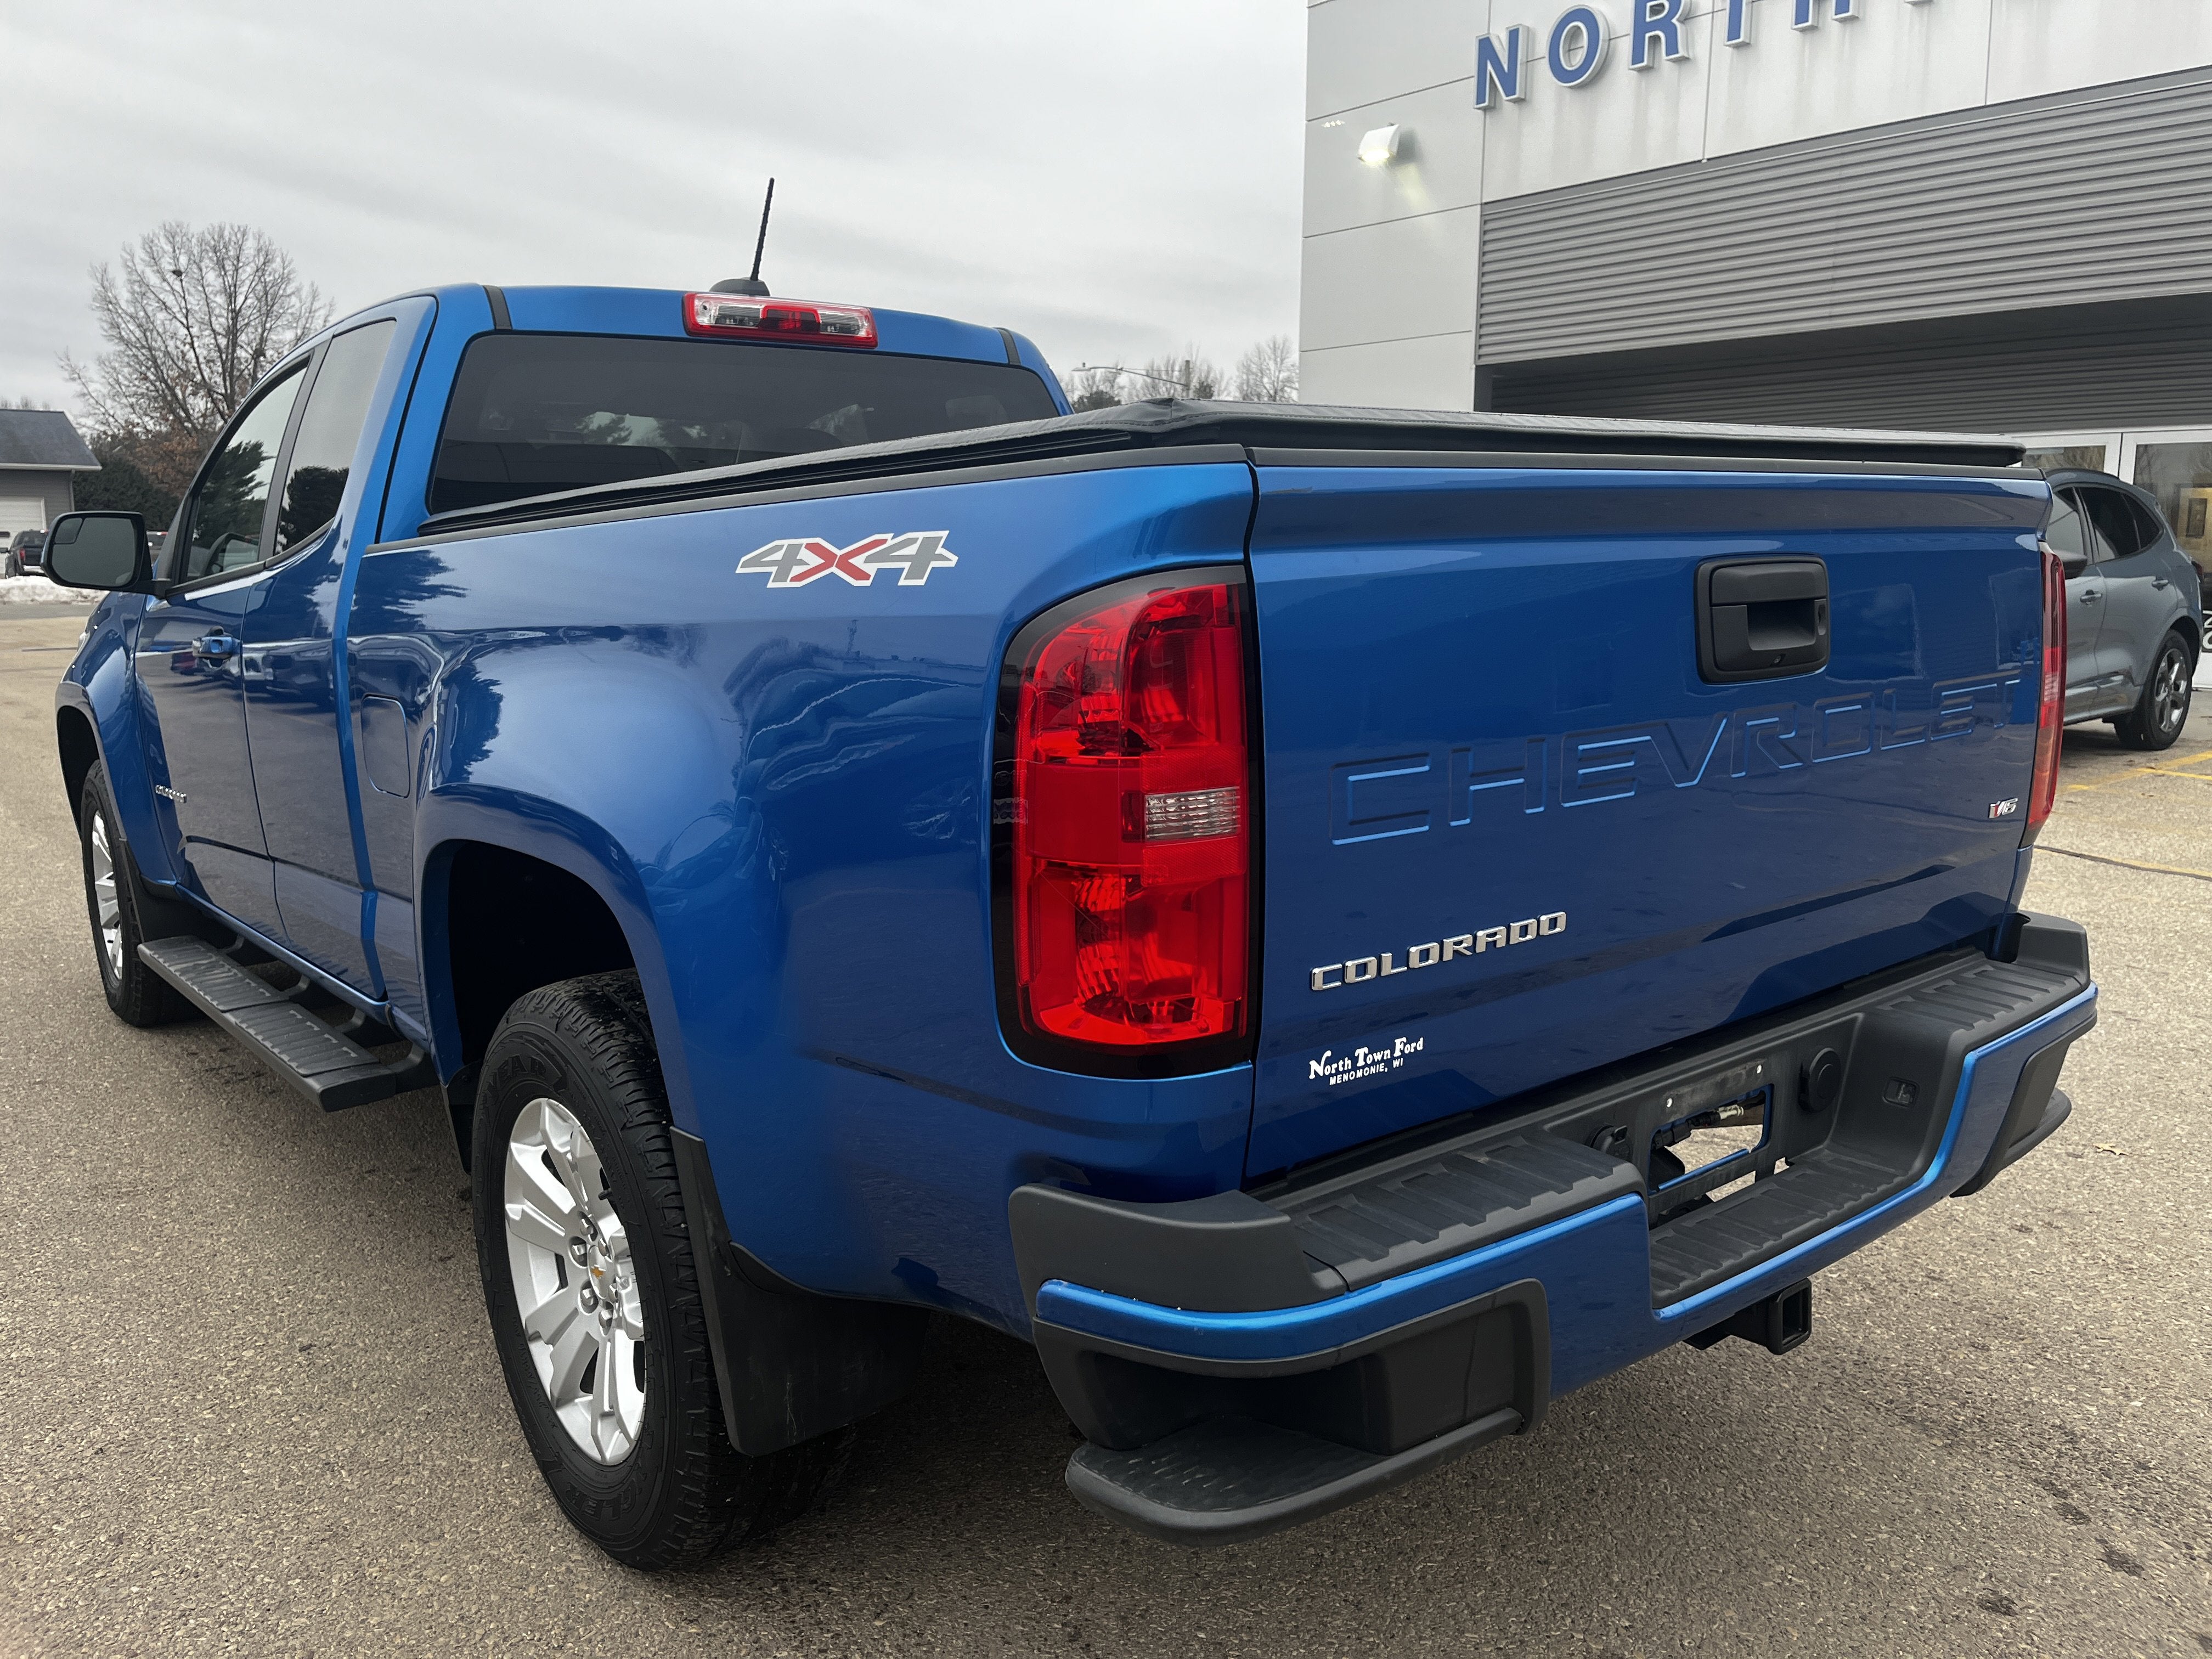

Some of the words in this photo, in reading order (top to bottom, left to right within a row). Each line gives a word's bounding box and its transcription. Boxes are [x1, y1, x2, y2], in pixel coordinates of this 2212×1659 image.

[1330, 670, 2022, 845] CHEVROLET
[1989, 797, 2018, 819] V6
[1311, 911, 1566, 991] COLORADO
[1309, 1050, 1351, 1079] North
[1355, 1046, 1391, 1066] Town
[1393, 1037, 1424, 1057] Ford
[1329, 1063, 1388, 1086] MENOMONIE,
[1392, 1058, 1403, 1068] WI
